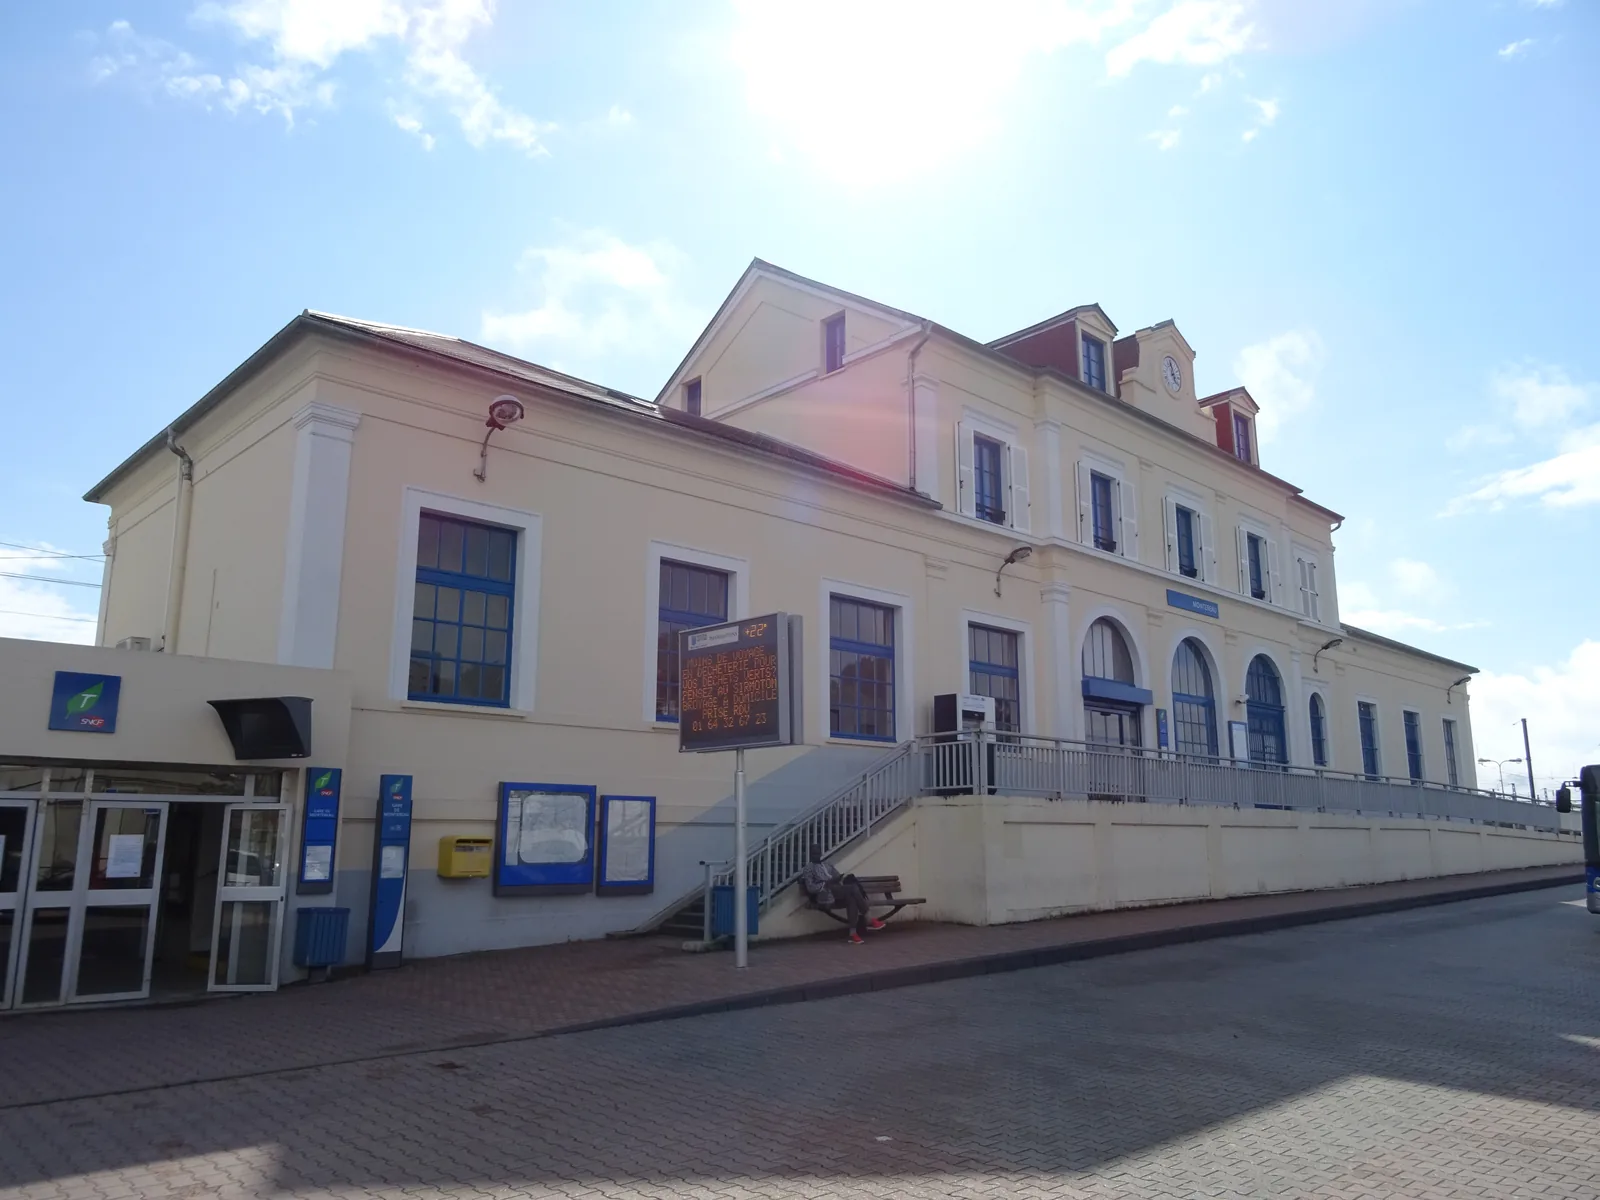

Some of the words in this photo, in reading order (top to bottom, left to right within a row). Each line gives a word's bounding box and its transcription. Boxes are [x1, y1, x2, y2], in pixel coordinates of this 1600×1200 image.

[716, 652, 727, 663] DE
[682, 668, 692, 679] EN
[717, 685, 728, 695] AU
[702, 707, 728, 719] PRISE
[80, 718, 105, 726] SNCF
[692, 720, 702, 731] 01
[707, 719, 718, 729] 64
[755, 713, 766, 724] 23
